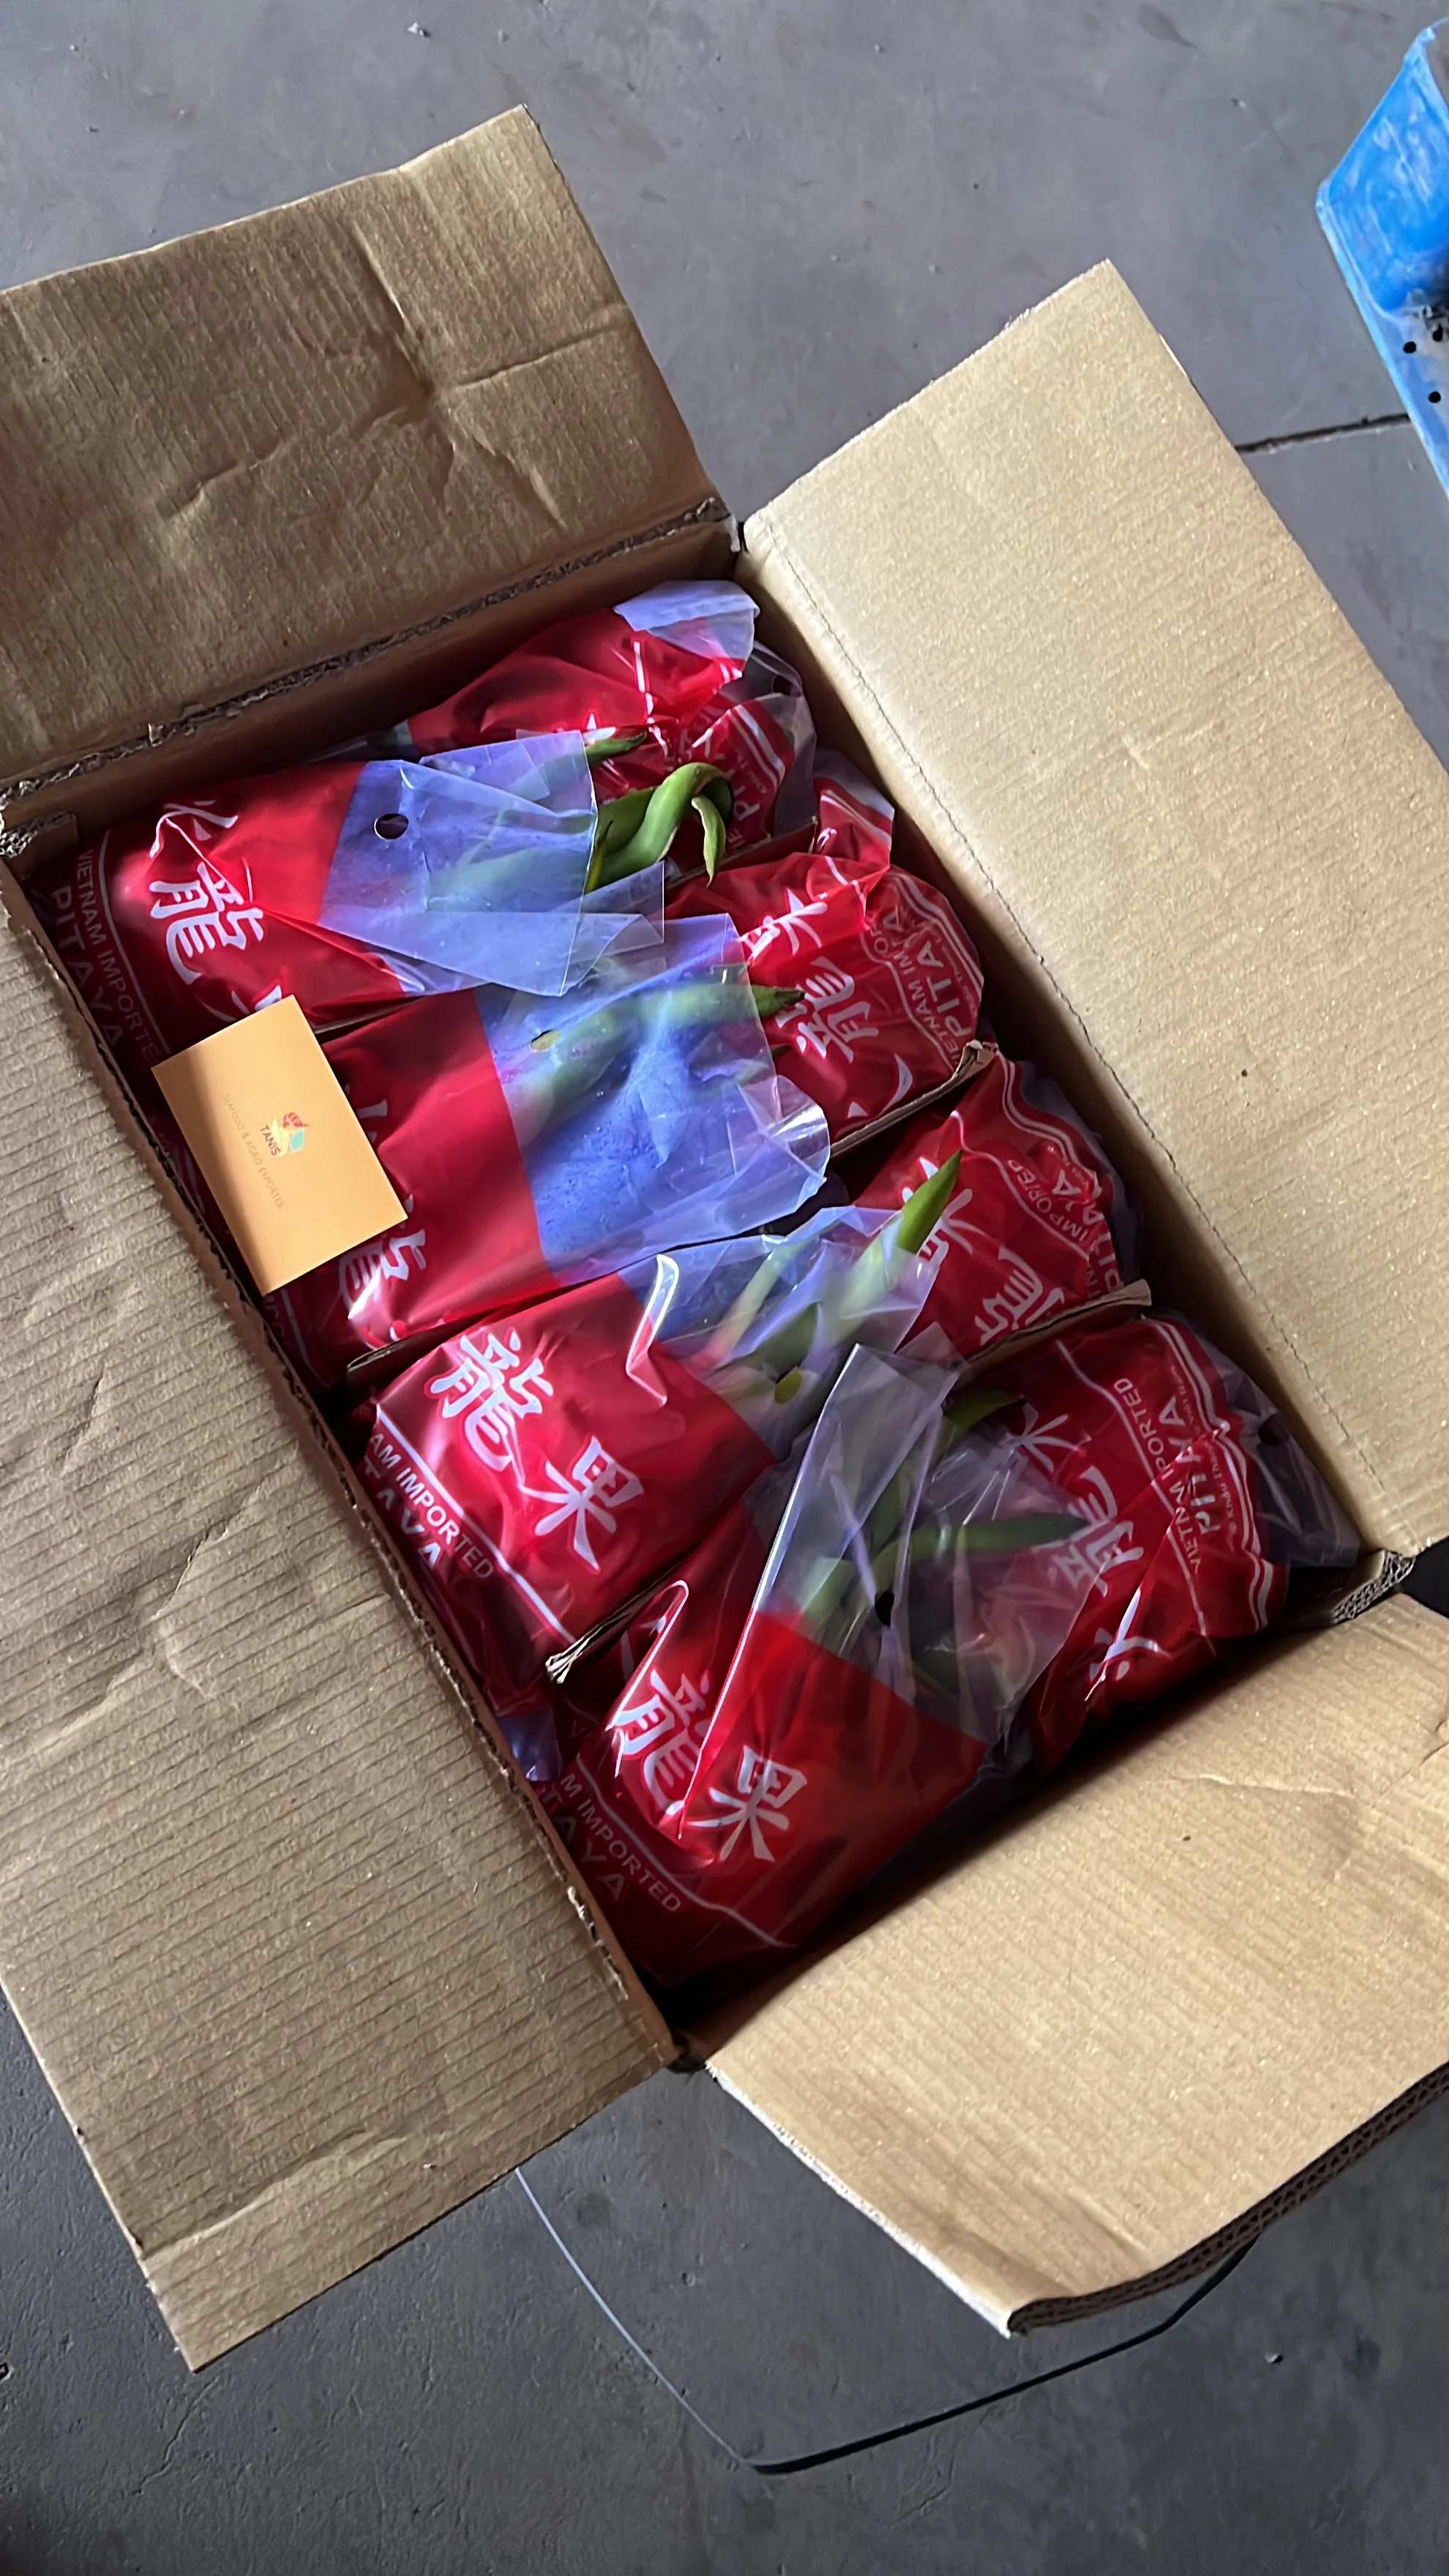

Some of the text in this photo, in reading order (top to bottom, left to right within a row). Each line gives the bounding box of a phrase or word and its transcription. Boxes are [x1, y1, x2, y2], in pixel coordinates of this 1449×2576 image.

[49, 885, 124, 1046] PITAYA
[75, 848, 161, 1063] VIETNAM IMPORTE
[907, 979, 959, 1063] IETNAM
[261, 1124, 282, 1156] TANIS
[395, 1467, 494, 1579] IMPORTED
[542, 1782, 626, 1903] TAYA
[577, 1798, 682, 1912] IMPORTED
